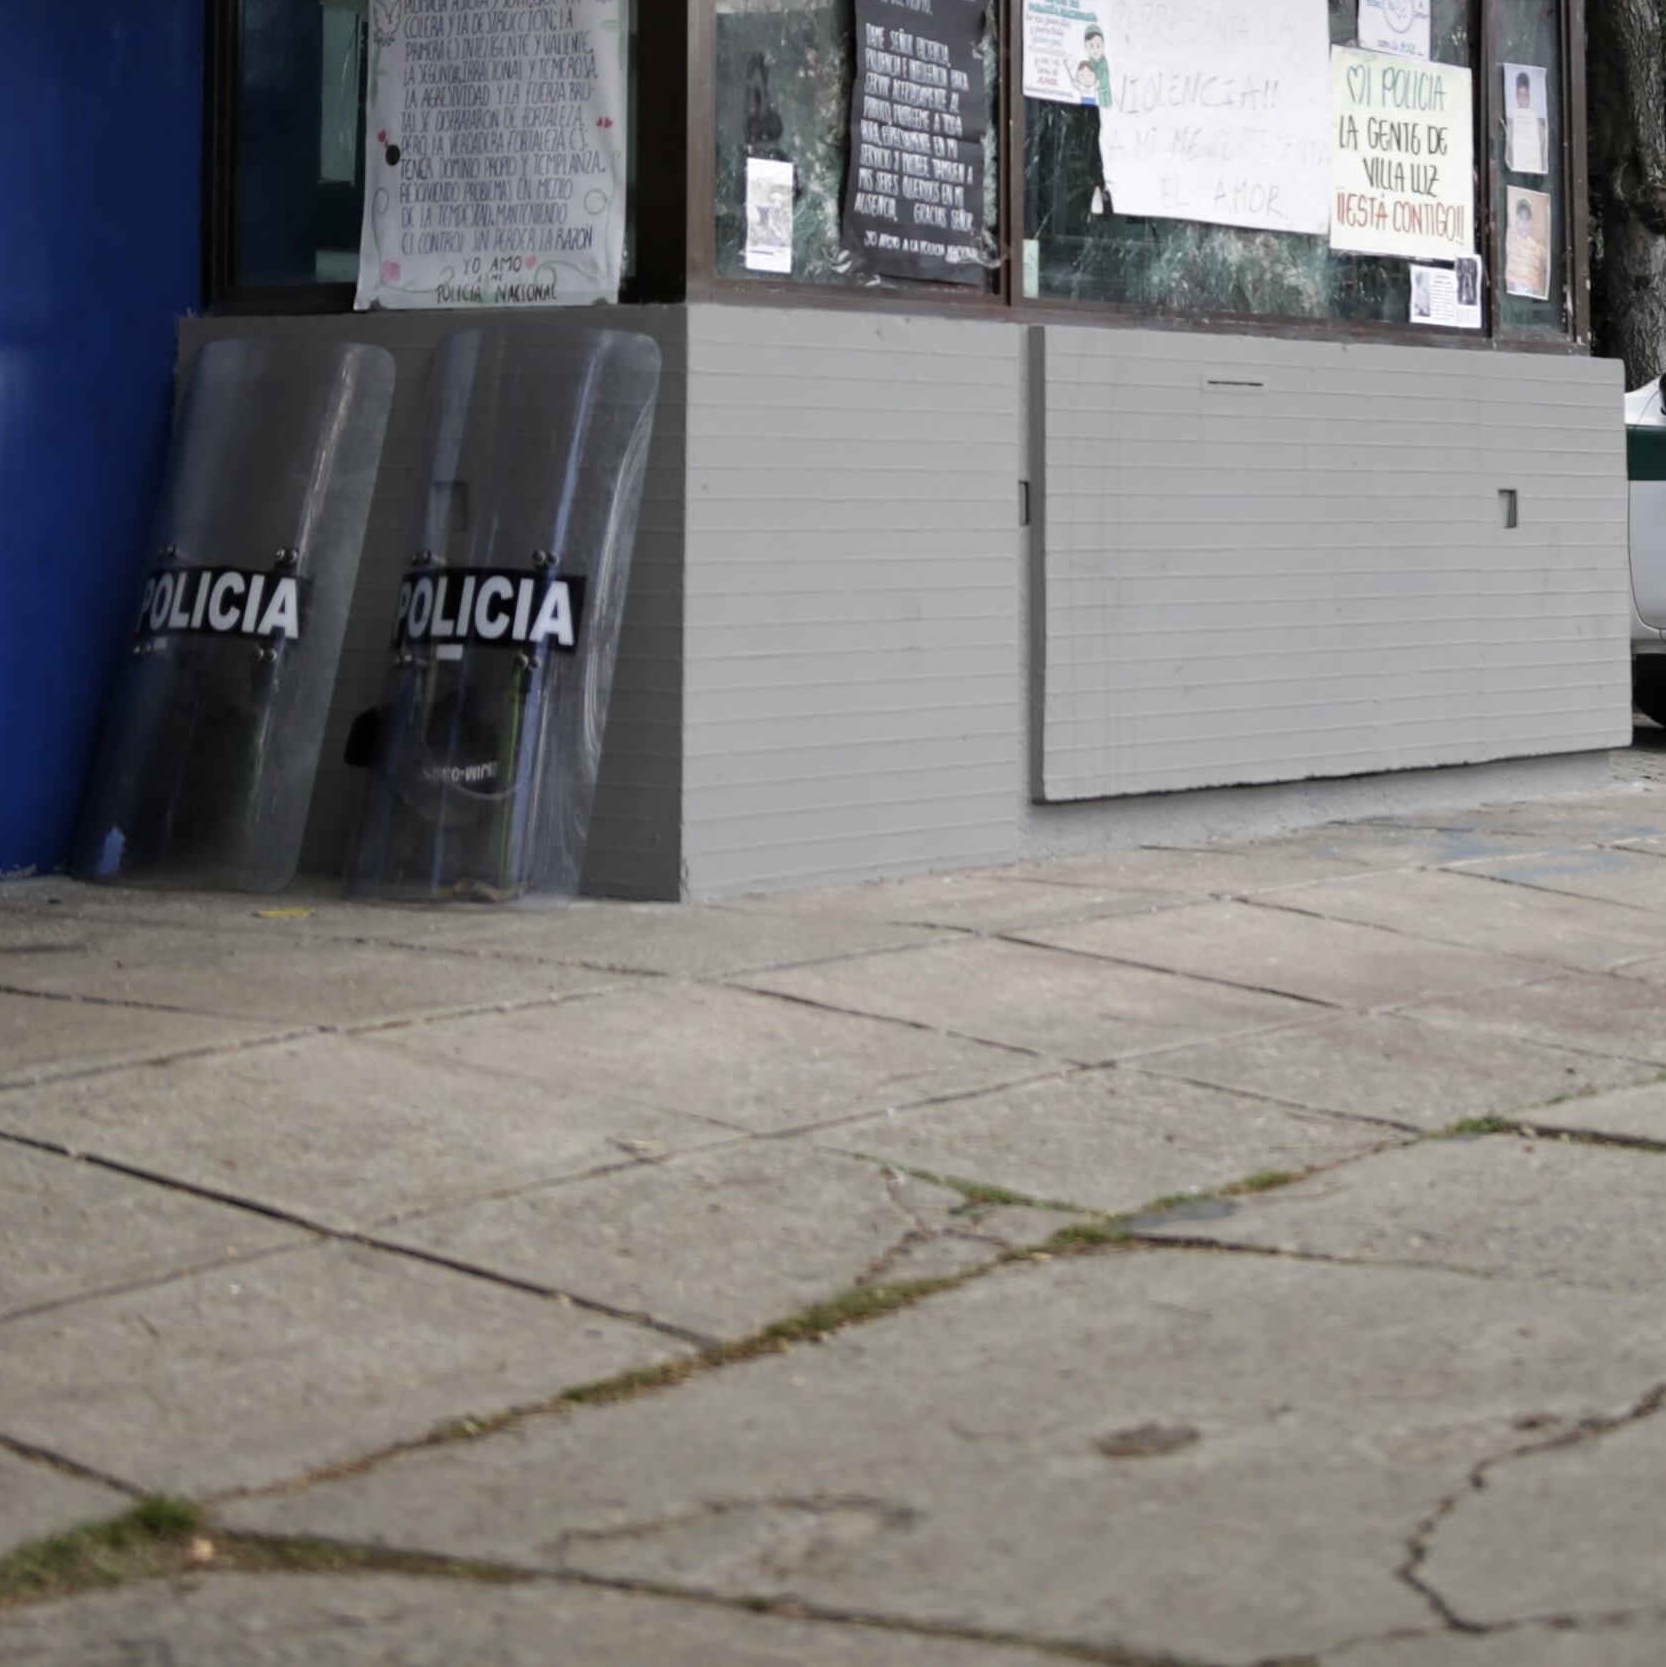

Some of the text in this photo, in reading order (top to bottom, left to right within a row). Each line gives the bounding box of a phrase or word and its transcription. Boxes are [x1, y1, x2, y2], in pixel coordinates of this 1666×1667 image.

[447, 14, 454, 34] Y
[458, 14, 468, 35] LA
[560, 8, 573, 29] LA
[462, 36, 530, 59] INTELIGENTE
[534, 35, 540, 55] Y
[404, 64, 414, 85] LA
[462, 59, 522, 82] IRRACIONAL
[528, 60, 534, 80] Y
[404, 88, 417, 109] LA
[497, 84, 503, 104] Y
[506, 84, 519, 103] LA
[525, 83, 565, 103] FUERZA
[1383, 67, 1447, 111] POLICIA
[402, 112, 415, 133] TAL
[420, 112, 430, 131] SE
[503, 108, 517, 129] DE
[432, 134, 443, 155] LA
[449, 130, 503, 153] VERDADERA
[508, 127, 566, 152] FORTALEZA
[1340, 115, 1447, 155] LA GENTE DE
[400, 158, 432, 180] TENER
[439, 158, 480, 179] DOMINIO
[521, 155, 528, 176] Y
[1363, 158, 1440, 197] VILLA LUZ
[463, 181, 512, 203] PROBLEMAS
[517, 180, 531, 201] EN
[536, 178, 573, 200] MEDIO
[401, 206, 414, 228] DE
[420, 206, 431, 227] LA
[495, 203, 567, 225] MANTENIENDO
[402, 233, 413, 255] EL
[418, 232, 463, 253] CONTROL
[472, 230, 489, 252] SIN
[493, 229, 535, 251] PERDER
[540, 229, 552, 251] LA
[463, 257, 522, 274] YO AMO
[437, 284, 557, 303] POLICIA NACIONAL
[137, 571, 300, 640] POLICIA
[398, 574, 575, 647] POLICIA
